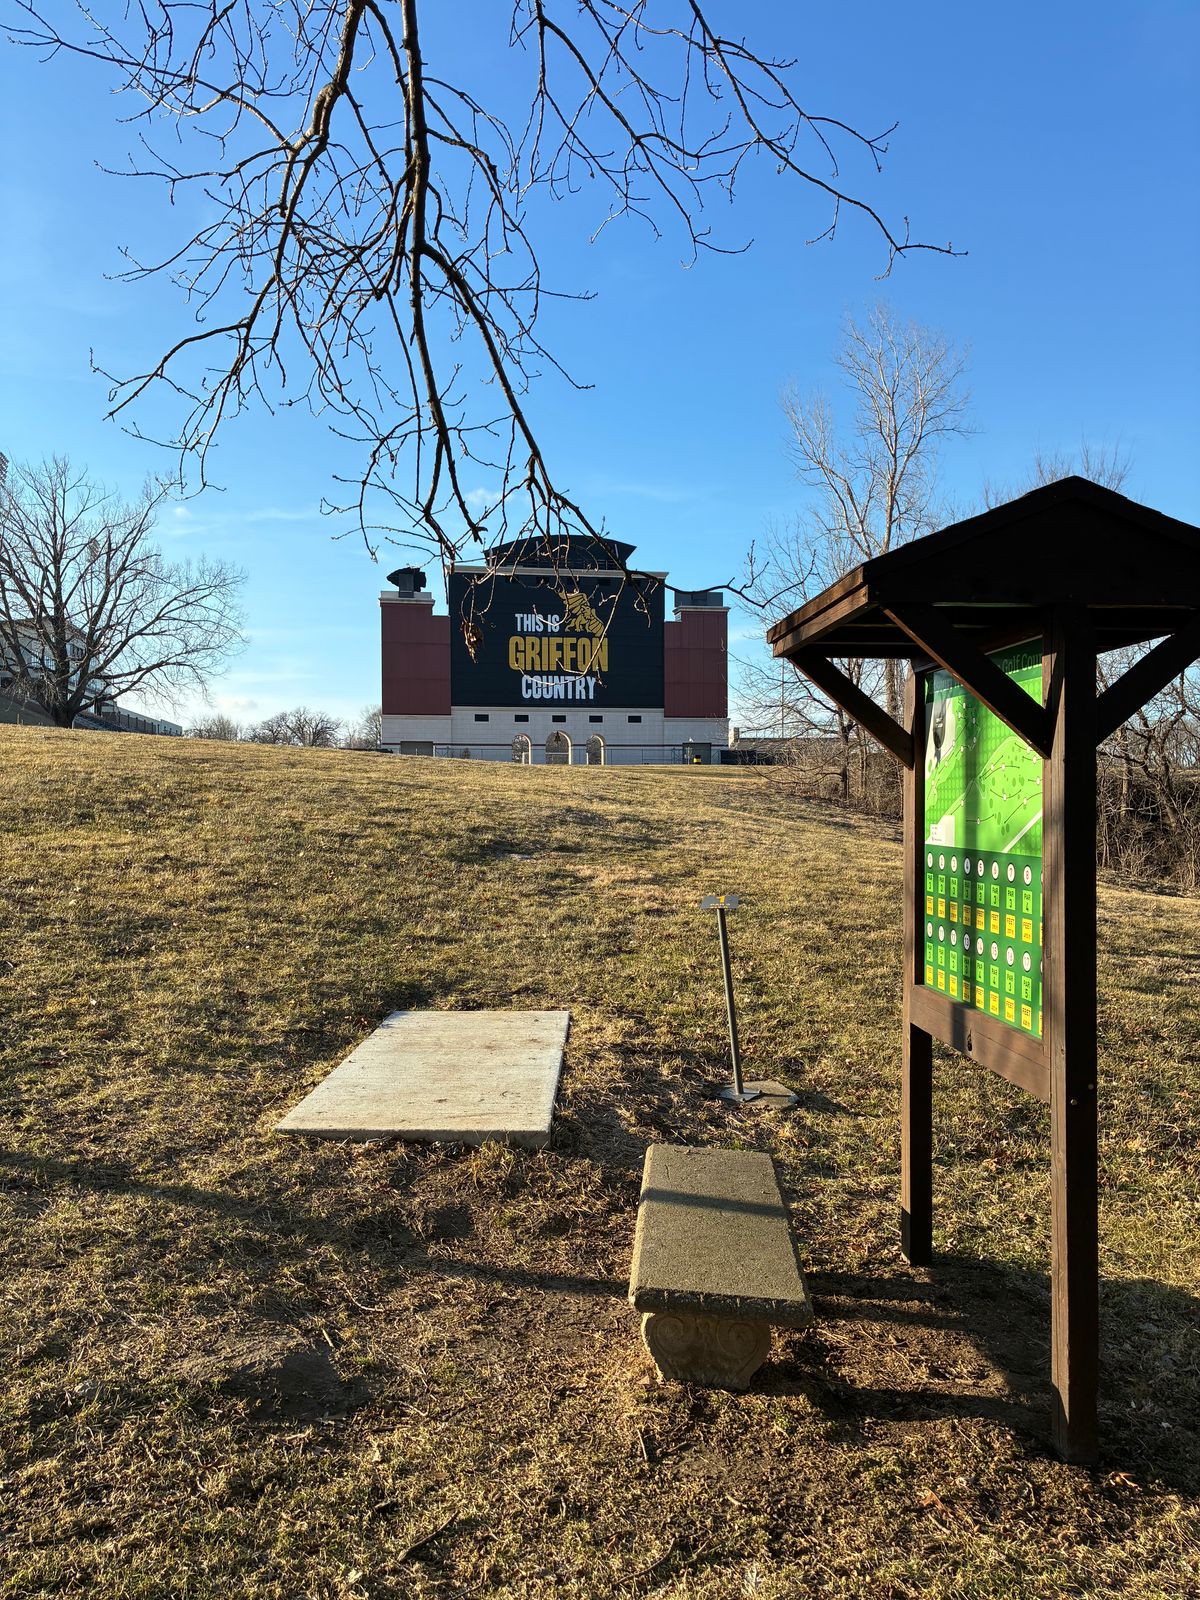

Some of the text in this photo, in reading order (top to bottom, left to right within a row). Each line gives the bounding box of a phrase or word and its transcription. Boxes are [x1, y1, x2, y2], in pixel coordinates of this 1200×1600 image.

[515, 613, 560, 633] THIS IS
[508, 635, 609, 672] GRIFFON
[1002, 654, 1020, 674] Golf
[521, 675, 597, 700] COUNTRY
